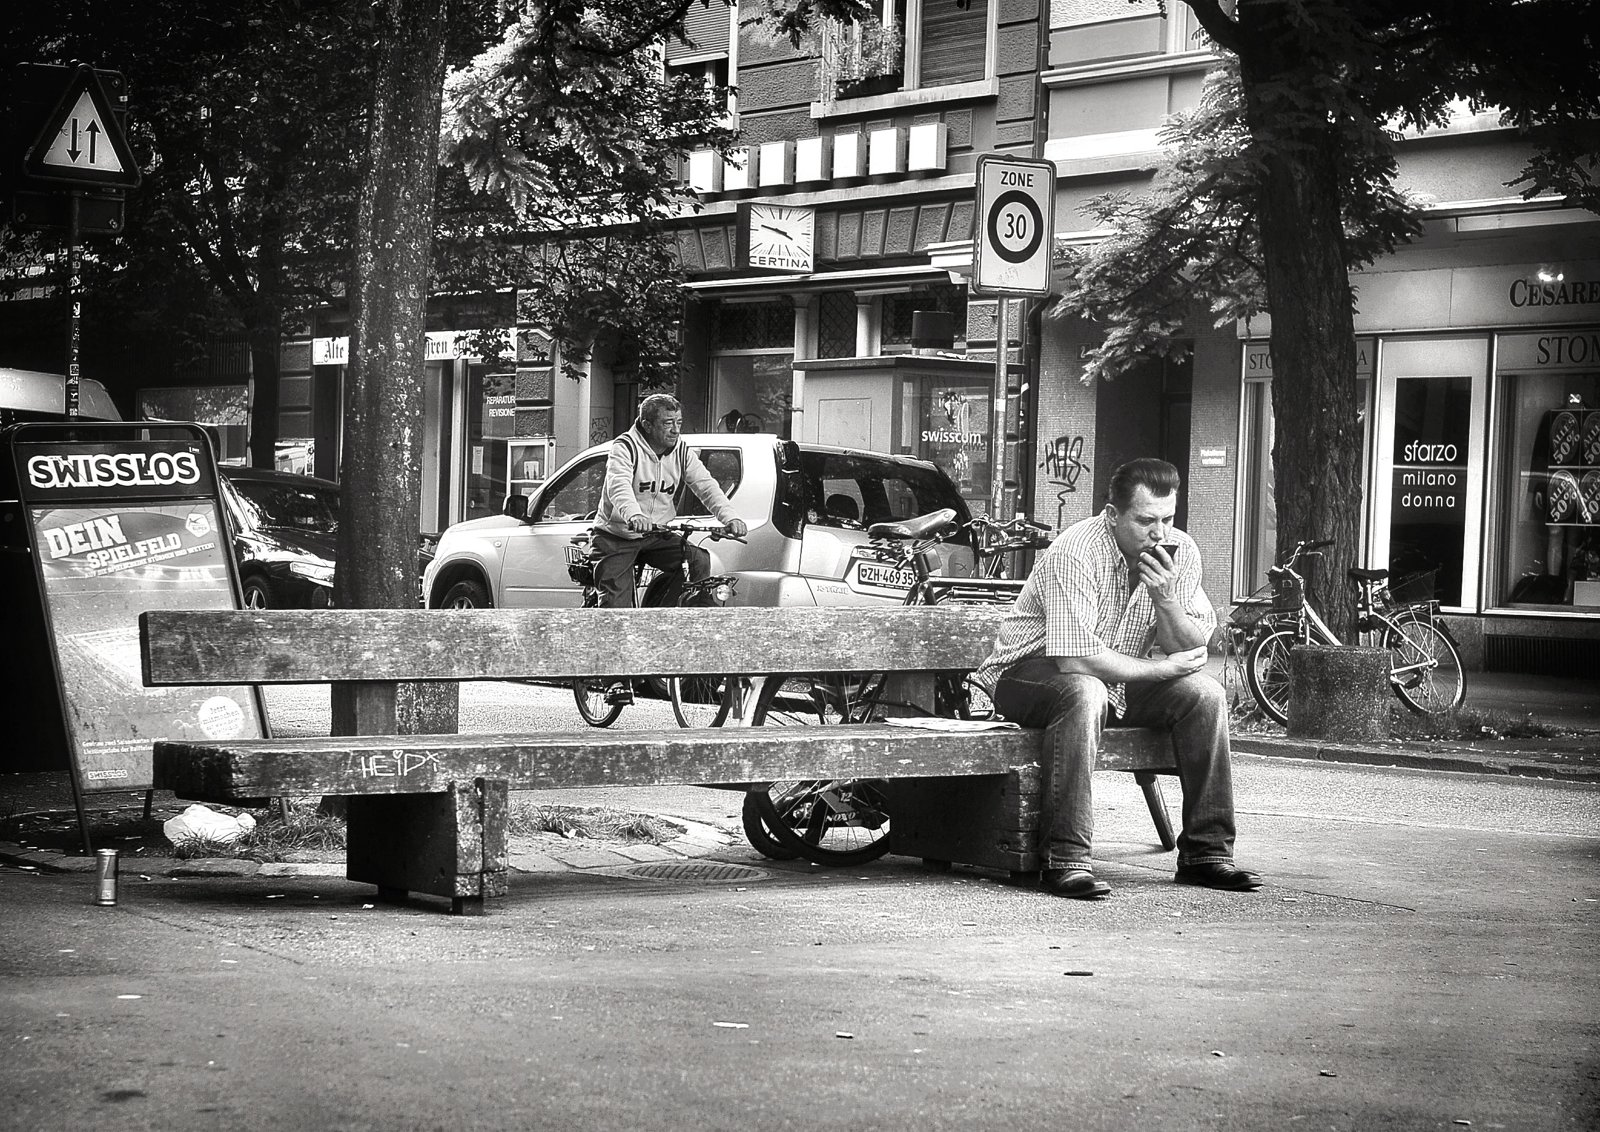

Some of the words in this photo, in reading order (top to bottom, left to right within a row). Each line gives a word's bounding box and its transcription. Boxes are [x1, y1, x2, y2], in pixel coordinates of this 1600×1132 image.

[1001, 170, 1034, 188] ZONE
[1004, 213, 1028, 240] 30
[749, 255, 810, 269] CERTINA
[1509, 279, 1600, 308] CESARE
[921, 428, 981, 444] swisscom
[1403, 439, 1457, 462] sfarzo
[29, 453, 199, 487] SWISSLOS
[1402, 470, 1457, 486] milano
[639, 480, 675, 495] FILA
[1401, 492, 1455, 508] donna
[43, 514, 127, 559] DEIN
[86, 532, 182, 570] SPIELFELD
